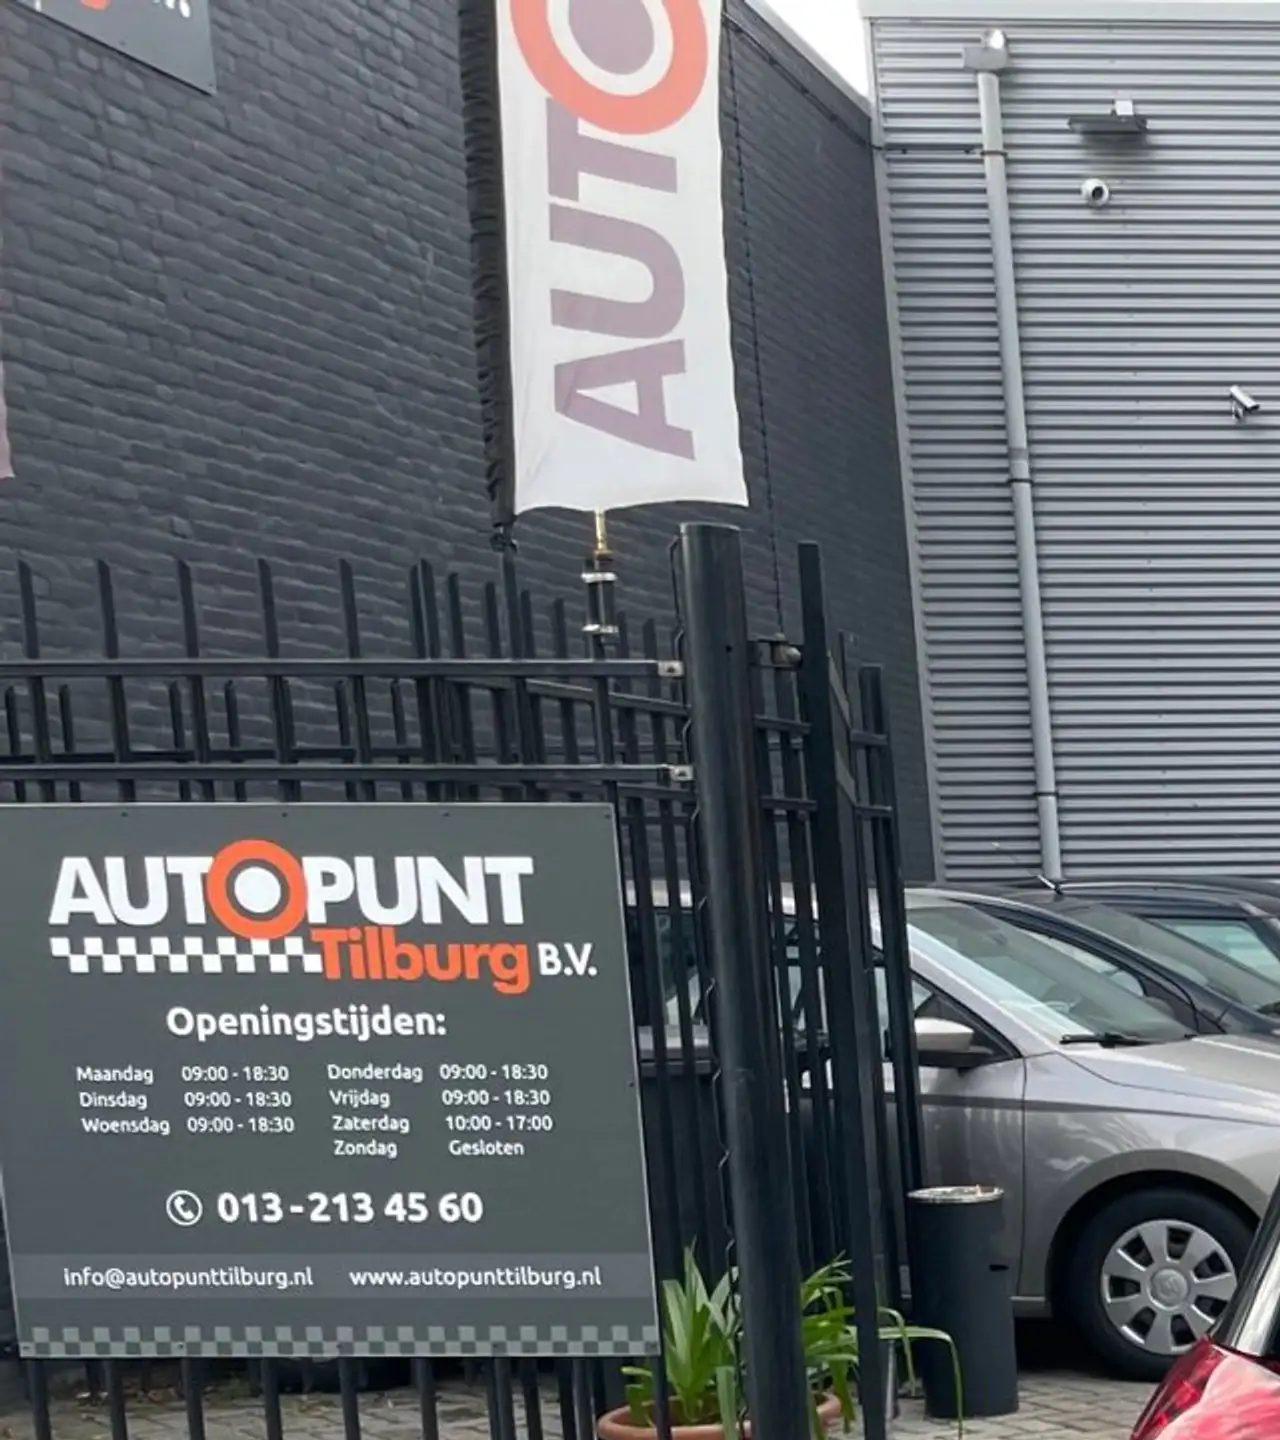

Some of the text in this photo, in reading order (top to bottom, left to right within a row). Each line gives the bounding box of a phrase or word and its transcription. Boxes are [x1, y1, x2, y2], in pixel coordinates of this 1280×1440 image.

[48, 839, 533, 940] AUTOPUNT
[310, 926, 598, 994] Tilburg B.V.
[166, 1005, 447, 1041] Openingstijden:
[76, 1065, 154, 1085] Maandag
[181, 1066, 228, 1082] 09:00
[242, 1066, 290, 1082] 18:30
[327, 1063, 423, 1083] Donderdag
[439, 1064, 487, 1080] 09:00
[502, 1064, 548, 1080] 18:30
[79, 1090, 148, 1110] Dinsdag
[184, 1091, 231, 1107] 09:00
[245, 1091, 292, 1107] 18:30
[329, 1088, 391, 1108] Vrijdag
[441, 1090, 489, 1105] 09:00
[504, 1090, 551, 1105] 18:30
[81, 1116, 171, 1135] Woensdag
[187, 1117, 234, 1132] 09:00
[248, 1117, 295, 1132] 18:30
[332, 1114, 410, 1133] Zaterdag
[445, 1115, 492, 1131] 10:00
[506, 1115, 553, 1131] 17:00
[334, 1139, 525, 1158] Zondag Gesloten
[384, 1191, 428, 1223] 45
[438, 1191, 483, 1223] 60
[63, 1266, 602, 1289] info@autopunttilburg.nl www.autopunttilburg.nl
